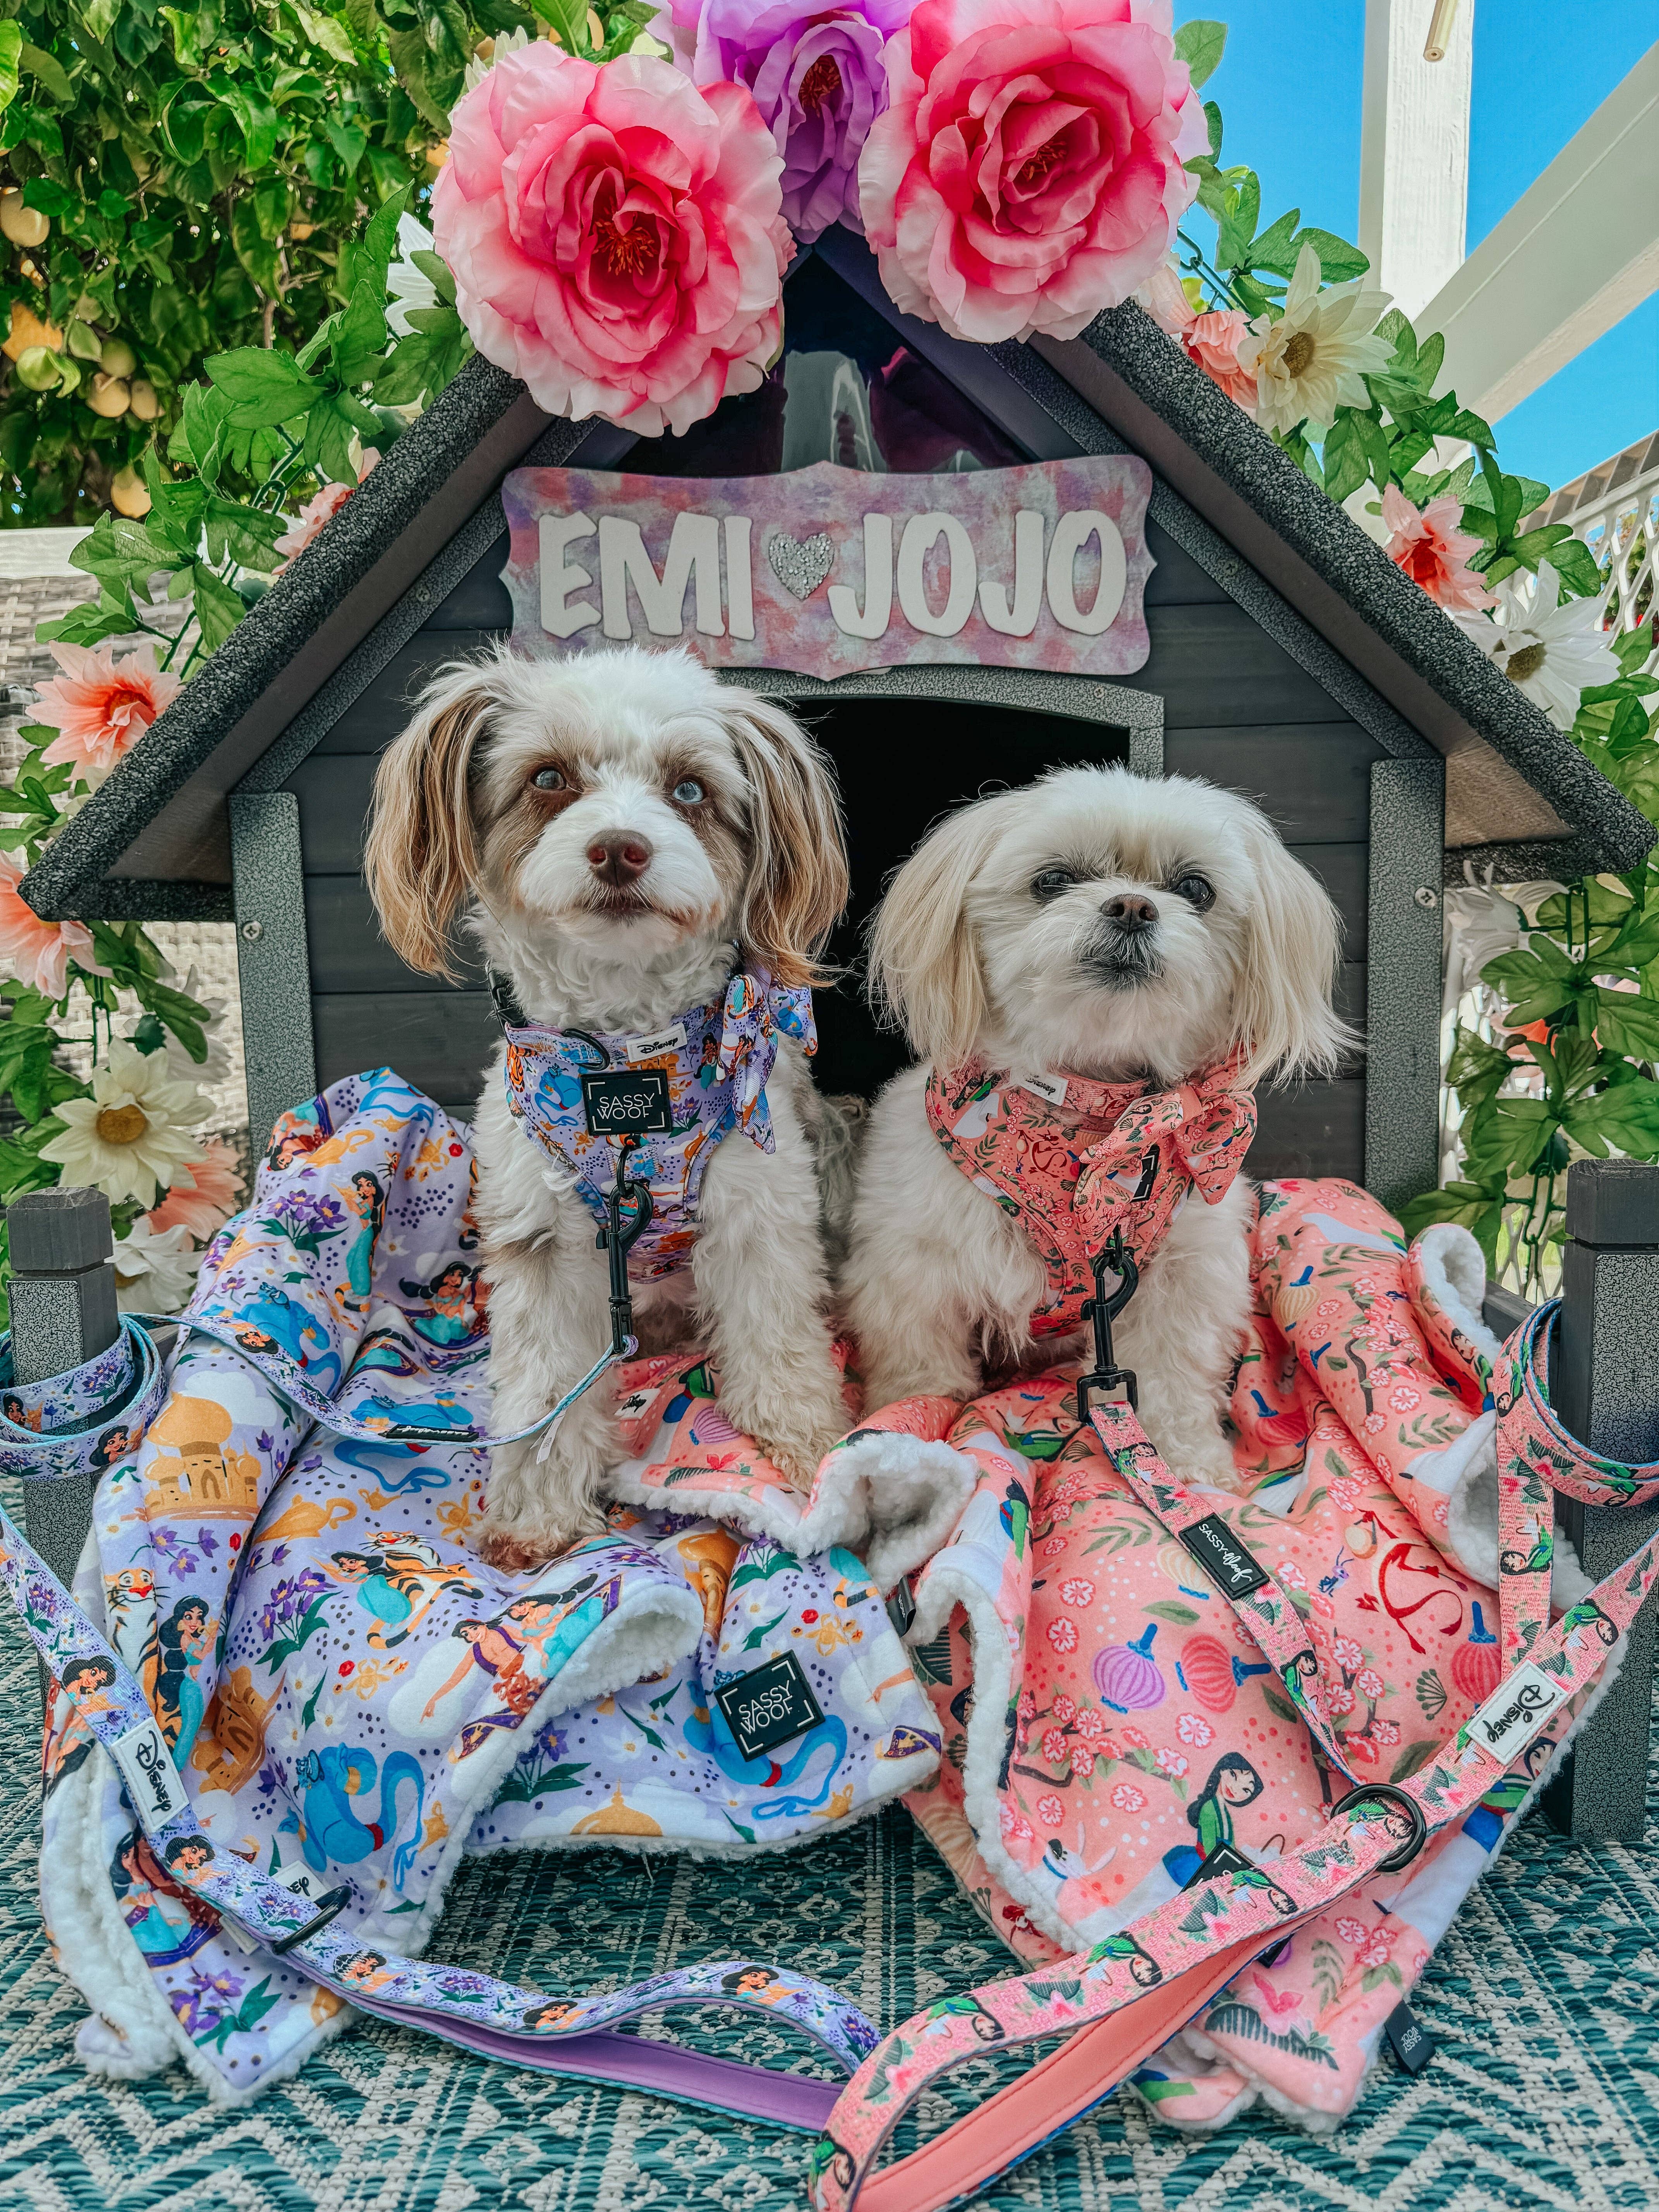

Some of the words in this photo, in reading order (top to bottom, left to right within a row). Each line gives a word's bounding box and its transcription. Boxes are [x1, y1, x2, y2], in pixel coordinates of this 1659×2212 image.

[539, 512, 756, 641] EMI
[828, 510, 1127, 640] JOJO
[637, 1037, 678, 1054] Disney
[597, 1105, 653, 1119] WOOF
[599, 1093, 654, 1109] SASSY
[1199, 1523, 1228, 1552] SASSY
[1223, 1551, 1254, 1583] Woof
[738, 1680, 790, 1720] SASSY
[740, 1695, 793, 1734] WOOF
[1482, 1685, 1556, 1743] Disney
[136, 1730, 172, 1812] Disney
[1401, 2025, 1419, 2044] WOOF
[1403, 2033, 1422, 2054] SASSY
